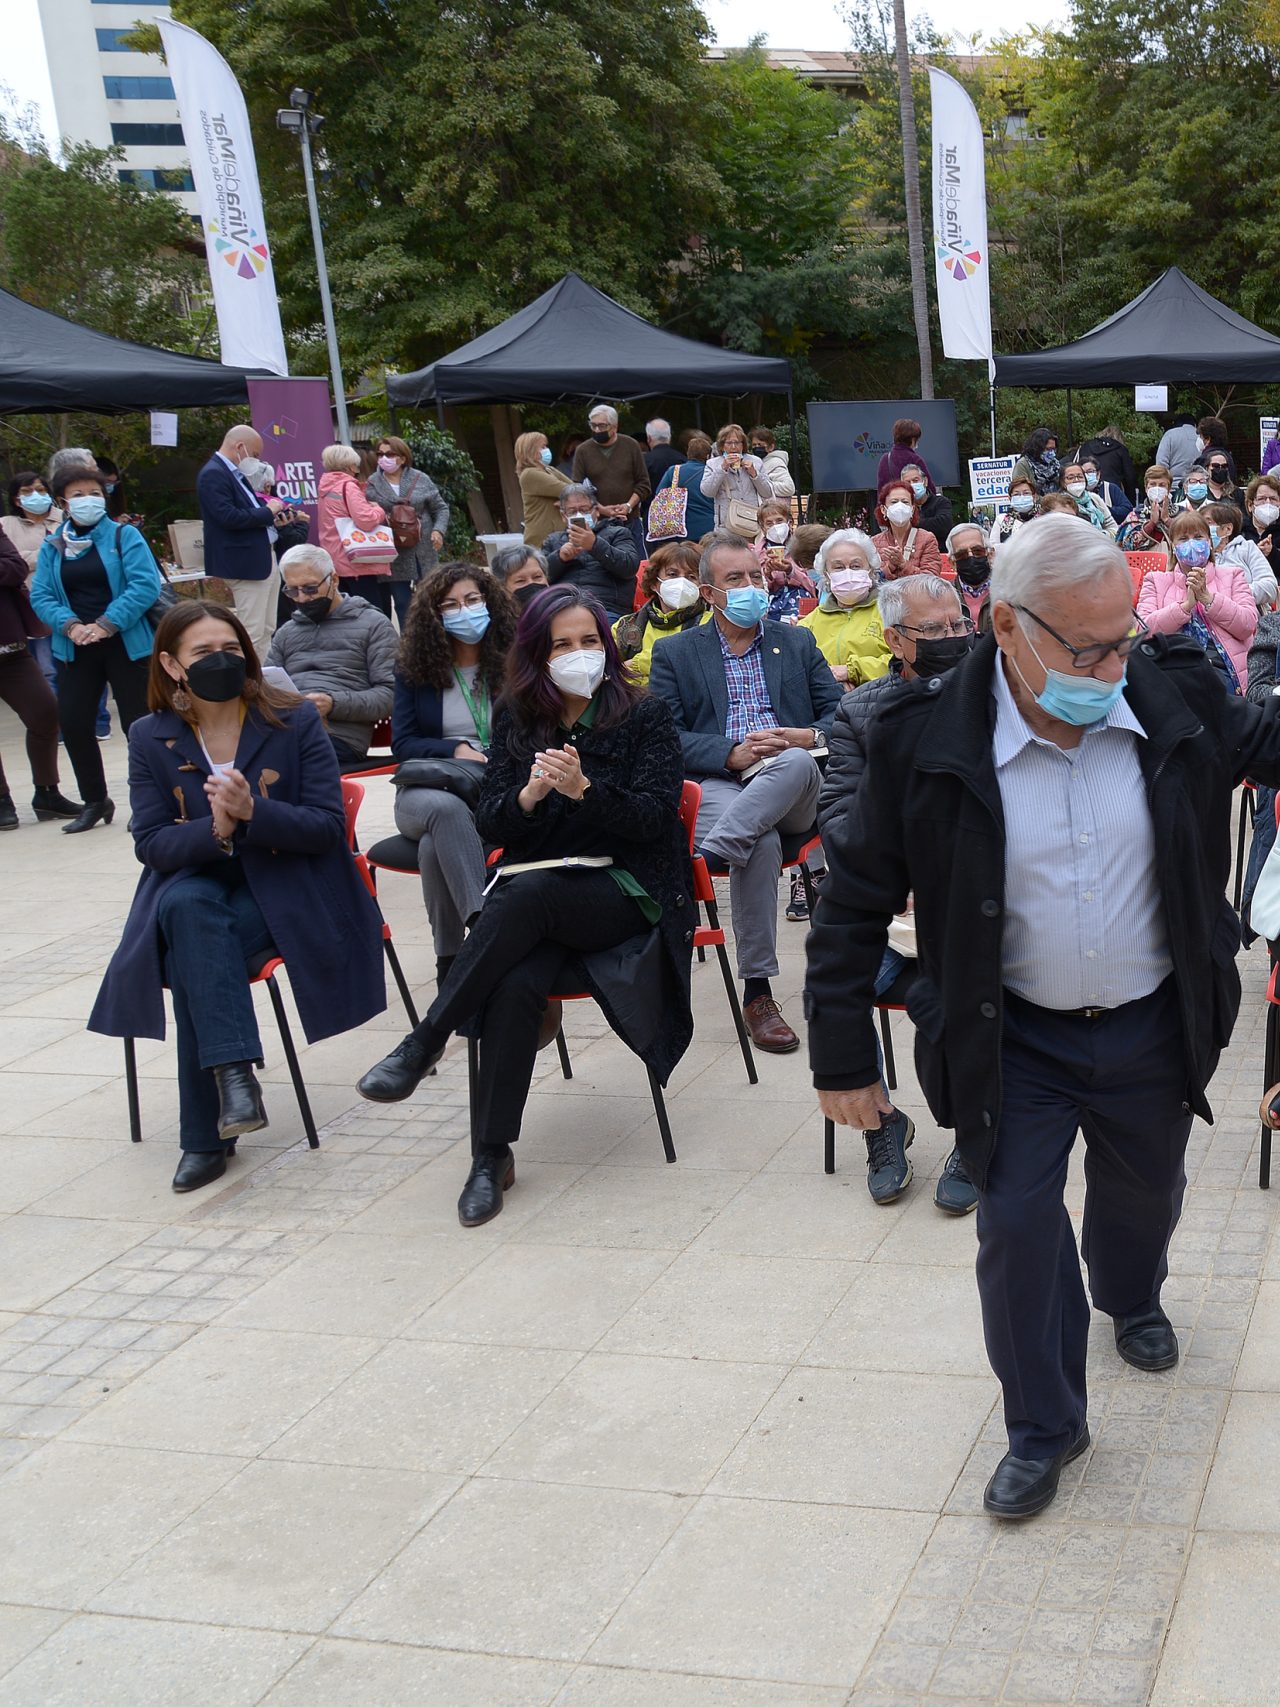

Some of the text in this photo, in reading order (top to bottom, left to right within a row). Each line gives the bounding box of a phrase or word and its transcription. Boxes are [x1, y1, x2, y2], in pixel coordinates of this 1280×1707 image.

[976, 461, 1008, 469] SERNATUR
[275, 461, 315, 481] ARTE
[975, 469, 1011, 477] vacaciones
[976, 475, 1012, 485] tercera
